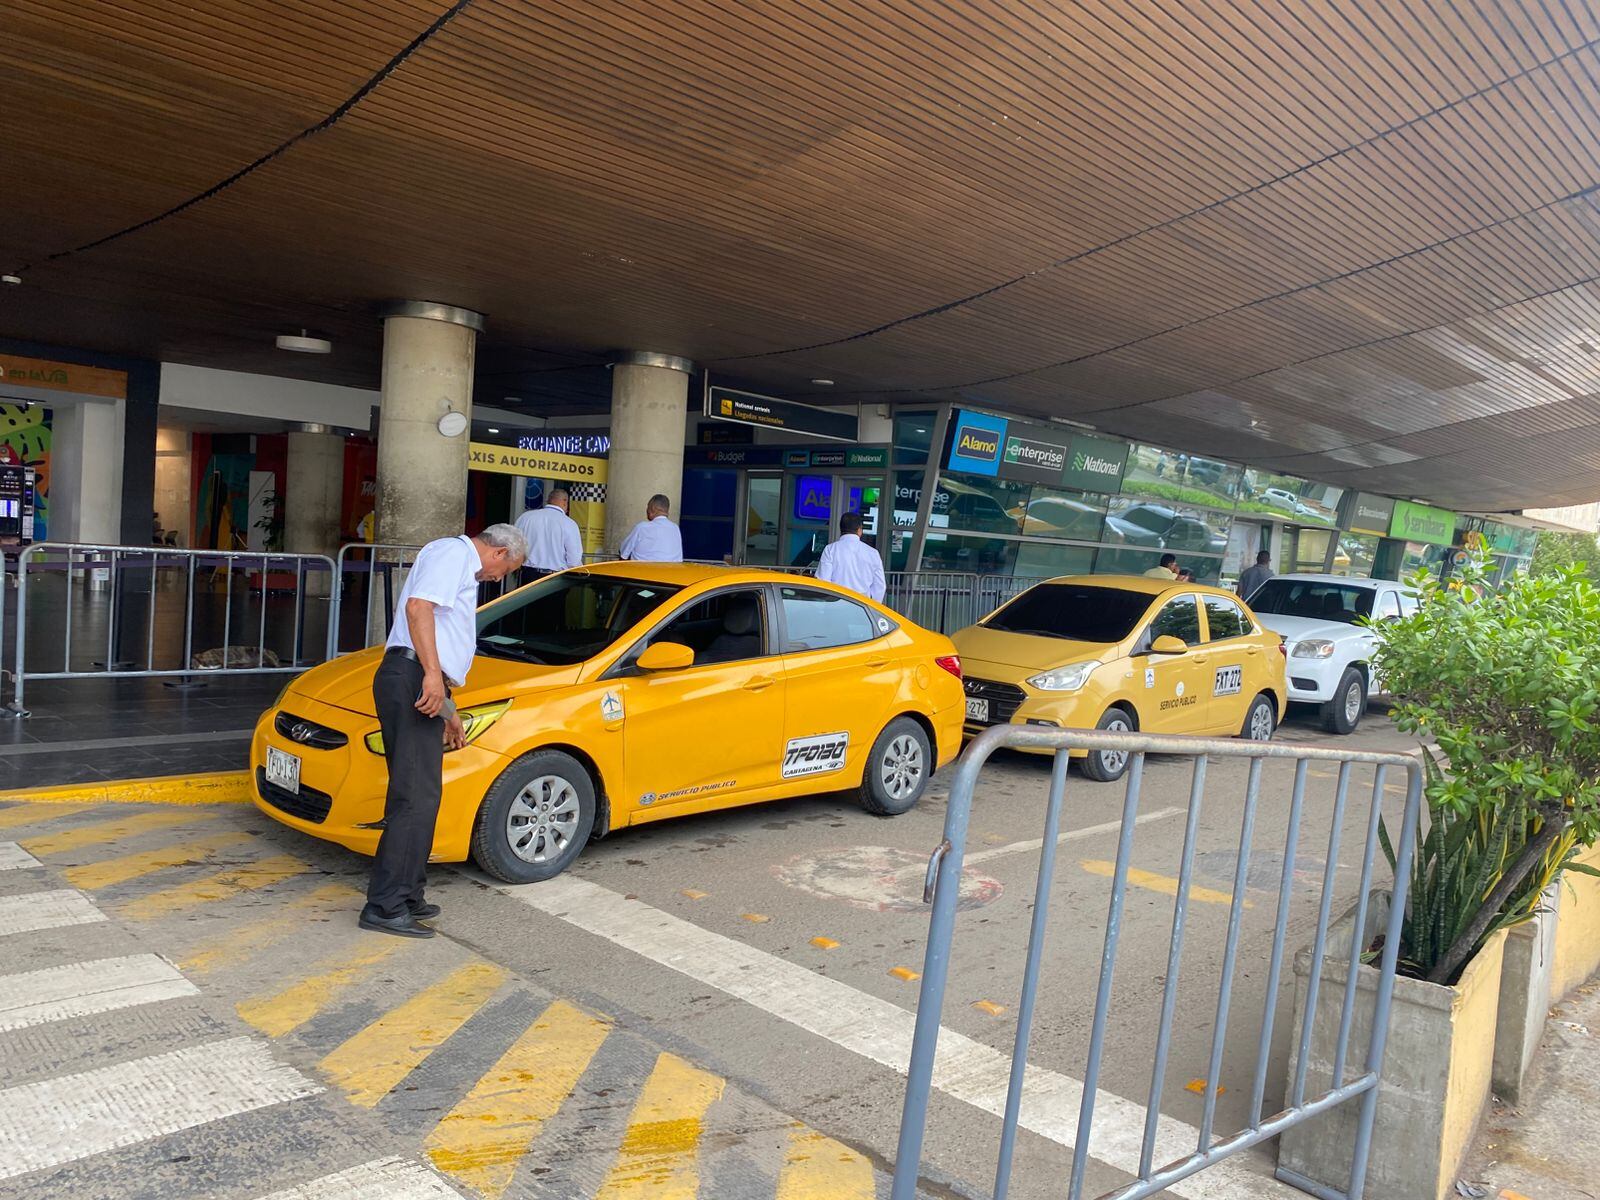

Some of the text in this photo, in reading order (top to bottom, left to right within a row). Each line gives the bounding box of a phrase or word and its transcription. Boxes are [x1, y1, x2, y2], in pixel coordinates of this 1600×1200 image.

[734, 401, 771, 414] National arrivals
[734, 410, 758, 420] Llegadas
[518, 435, 582, 453] EXCHANGE
[960, 434, 996, 453] Alamo
[717, 450, 745, 464] Budget
[857, 454, 882, 463] National
[1009, 443, 1063, 463] enterprise
[500, 455, 594, 476] AUTORIZADOS
[1083, 455, 1121, 475] National
[1160, 698, 1179, 710] SERVICIO
[783, 764, 823, 776] CARTAGENA
[657, 780, 737, 801] SERVICIO PUBLICO
